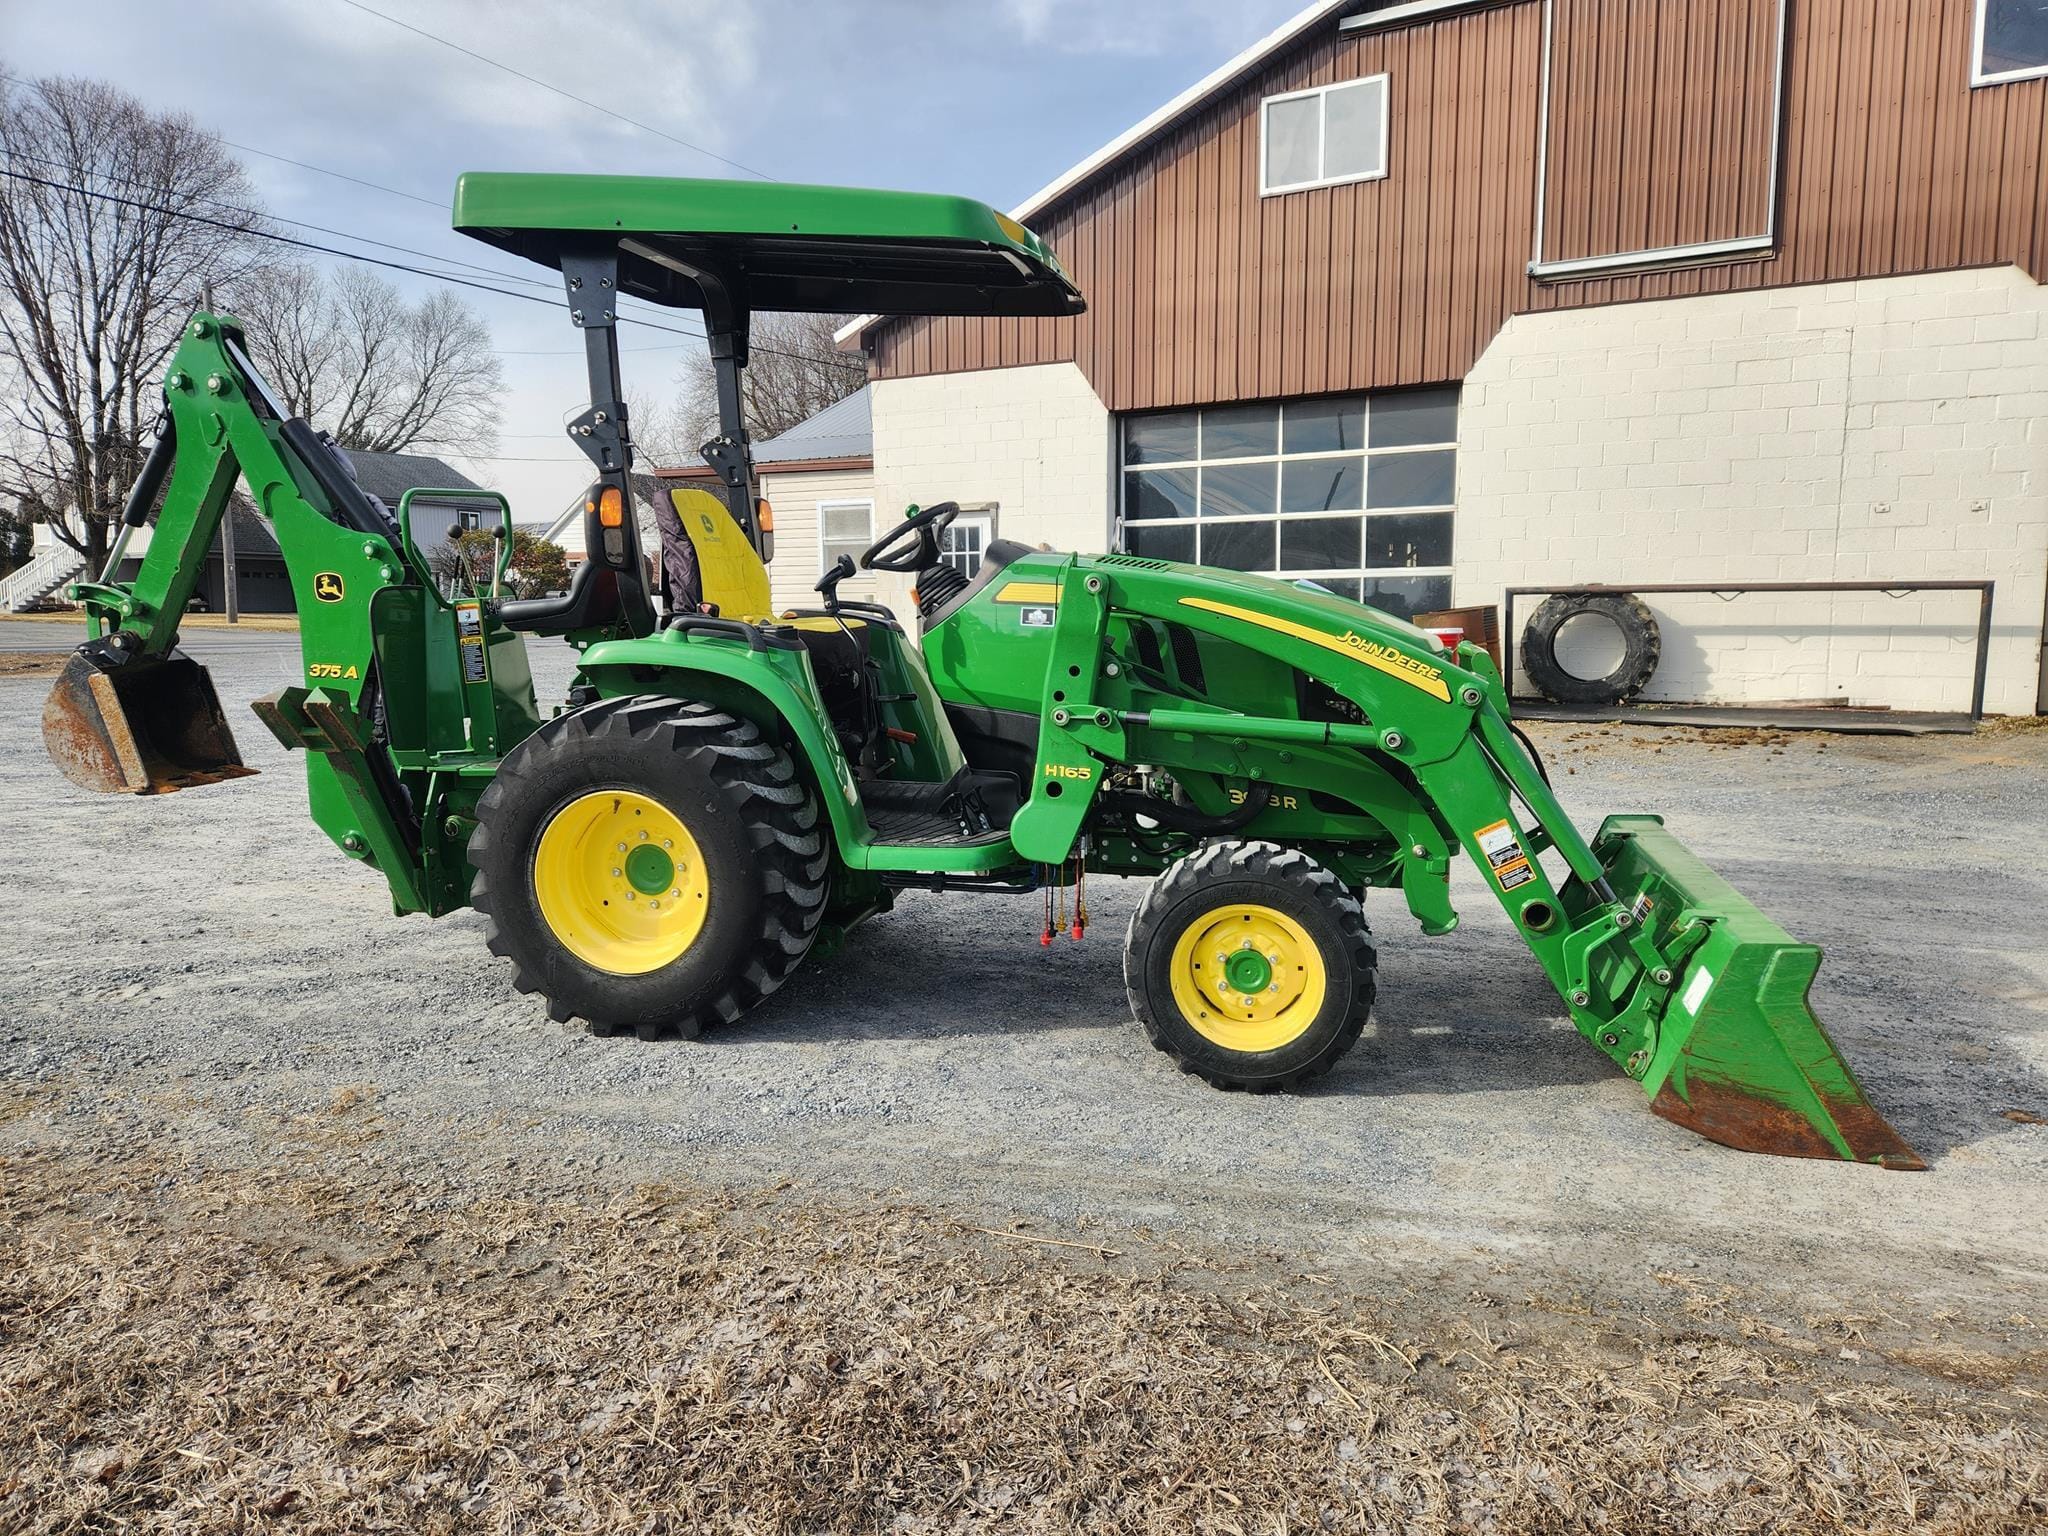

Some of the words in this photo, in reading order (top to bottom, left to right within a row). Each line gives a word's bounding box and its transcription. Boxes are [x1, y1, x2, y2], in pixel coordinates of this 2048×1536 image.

[1336, 630, 1384, 658] JOHN
[1380, 647, 1444, 682] DEERE
[309, 663, 342, 678] 375
[343, 665, 359, 680] A
[1045, 764, 1091, 780] H165
